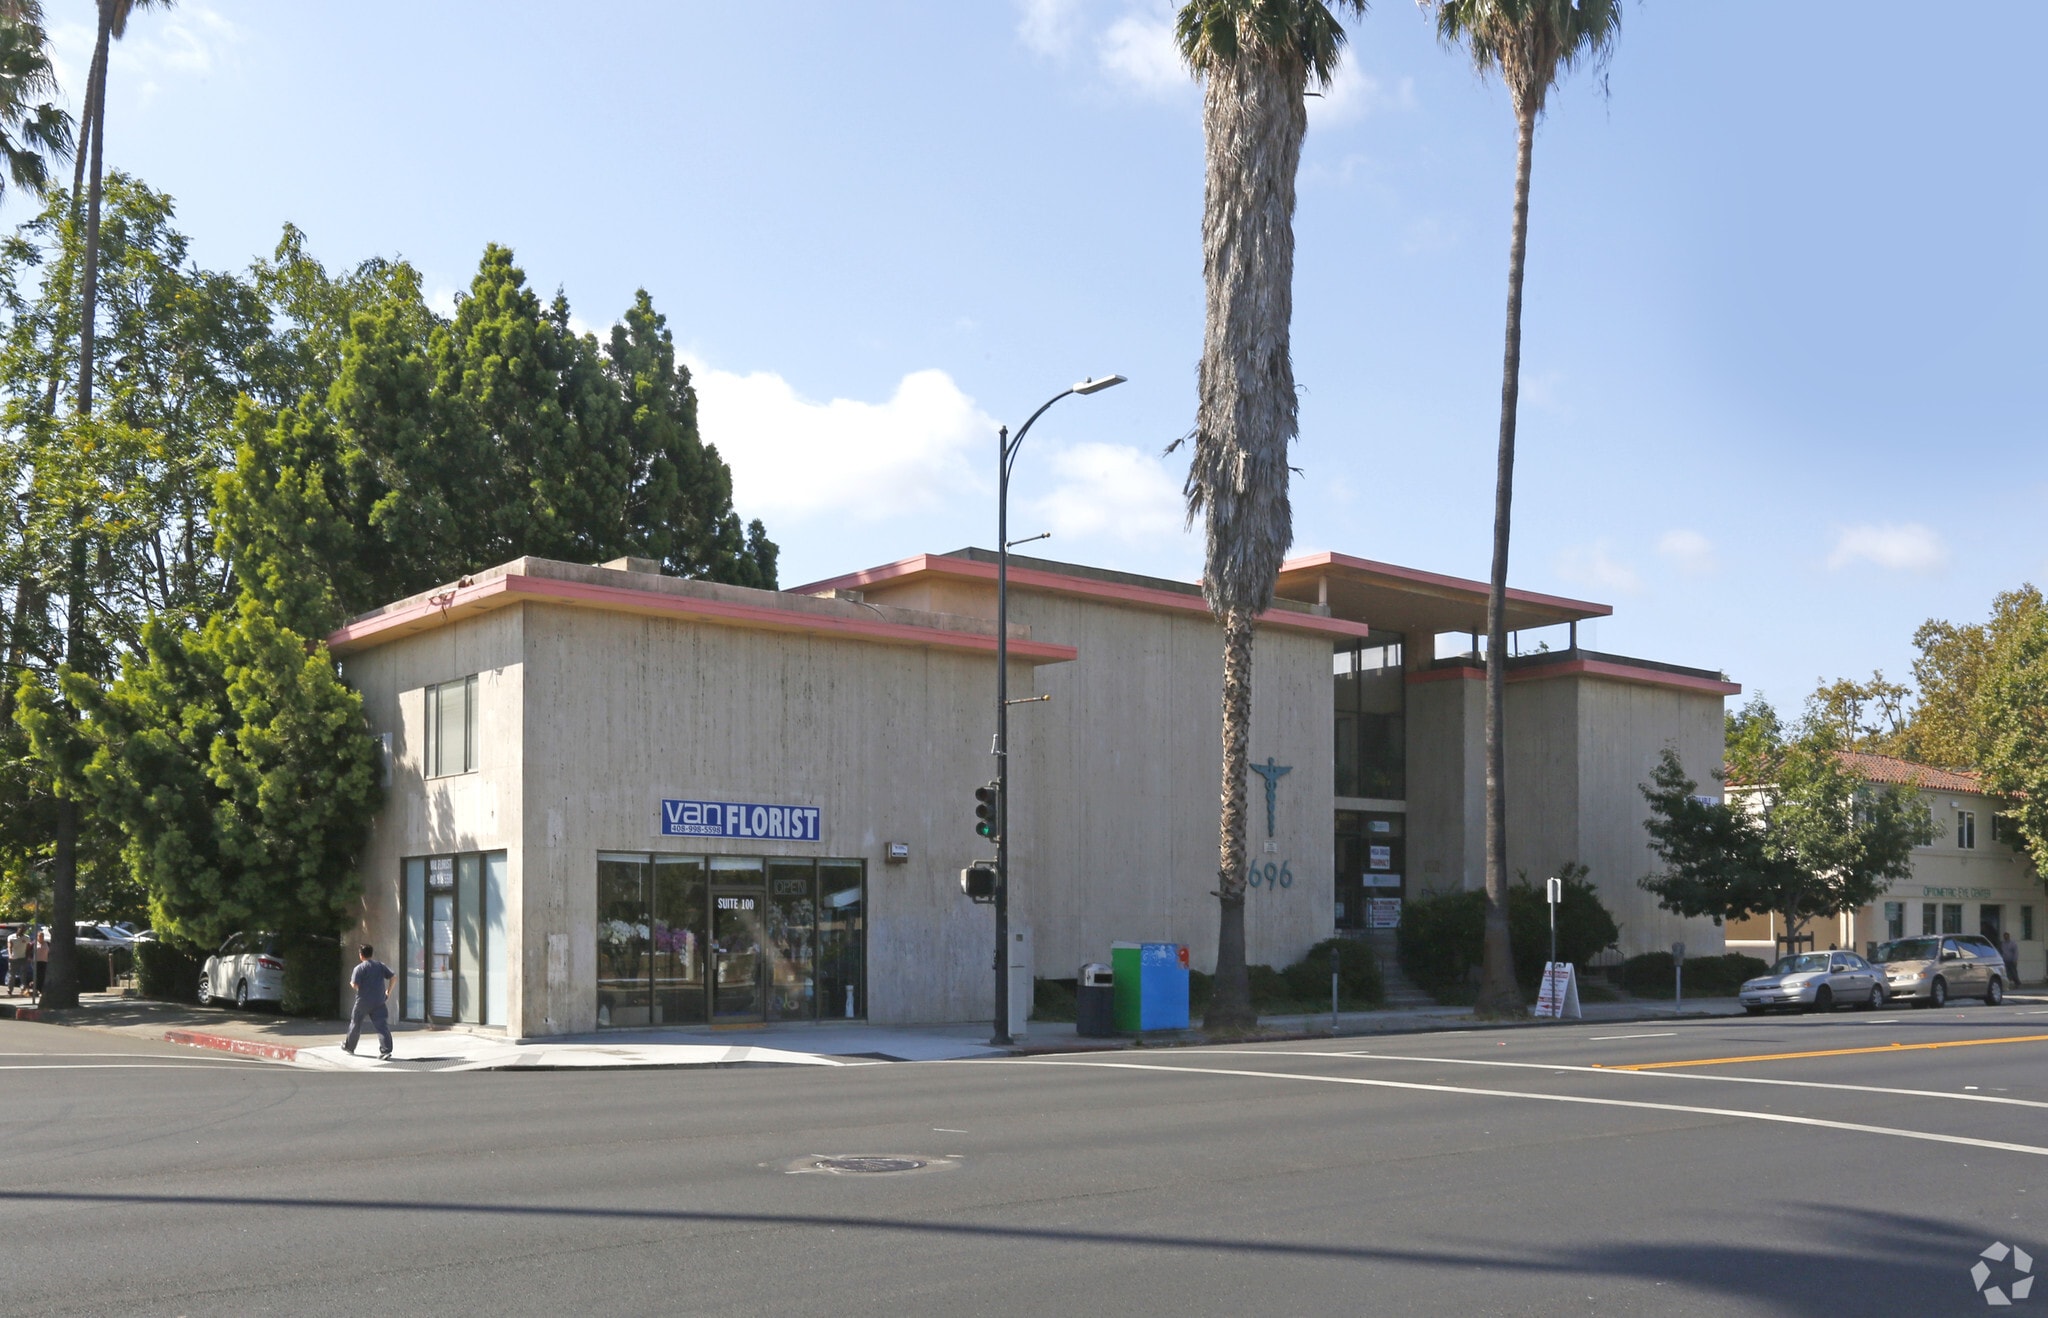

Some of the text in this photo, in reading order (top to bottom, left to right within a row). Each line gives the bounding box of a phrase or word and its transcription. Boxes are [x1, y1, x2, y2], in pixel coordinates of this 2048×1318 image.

[726, 805, 818, 839] FLORIST
[671, 825, 721, 834] 408-998-5598
[1249, 858, 1293, 891] 696
[775, 880, 806, 894] OPEN
[1958, 887, 1969, 898] EYE
[1971, 887, 1991, 899] CENTER
[717, 898, 755, 910] SUITE 100
